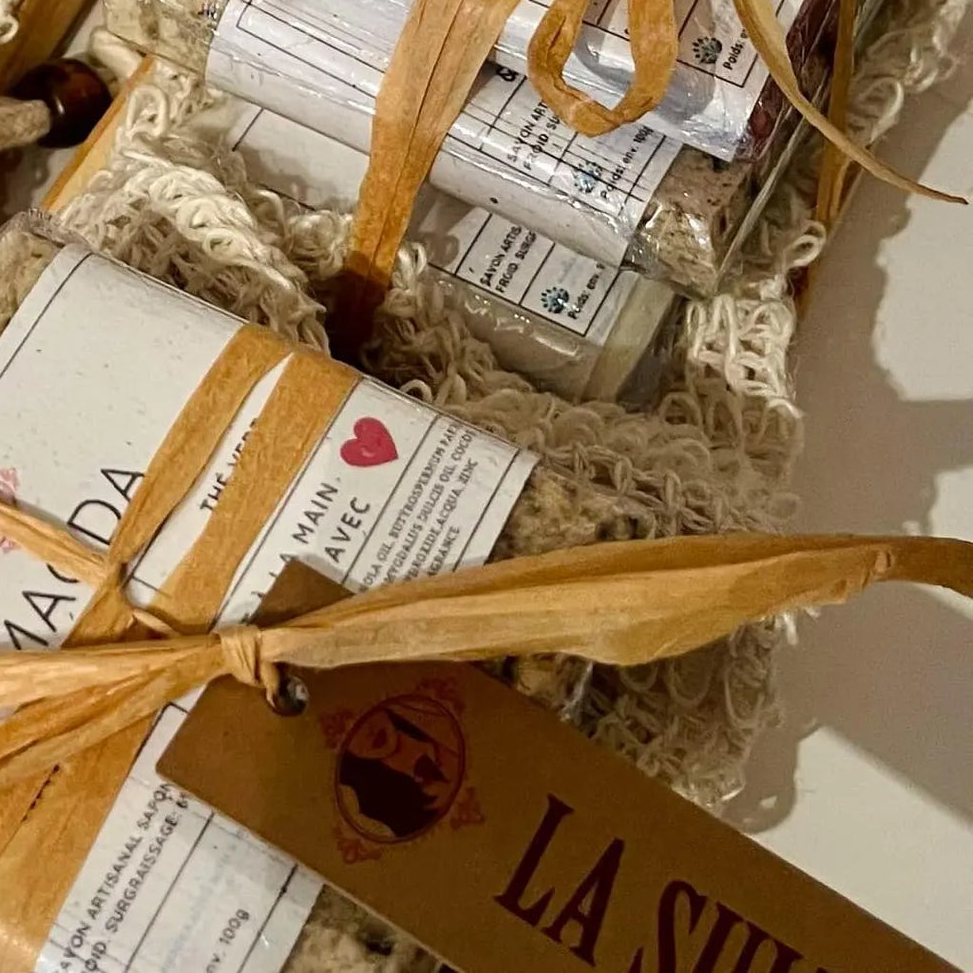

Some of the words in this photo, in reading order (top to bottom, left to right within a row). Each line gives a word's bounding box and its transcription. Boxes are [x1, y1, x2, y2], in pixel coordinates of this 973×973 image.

[479, 249, 505, 288] SAVON
[291, 482, 339, 544] MAIN
[325, 497, 370, 563] AVEC
[55, 920, 91, 973] AVON
[87, 835, 143, 920] ARTISANAL
[493, 793, 626, 967] LA
[219, 909, 250, 945] 100g
